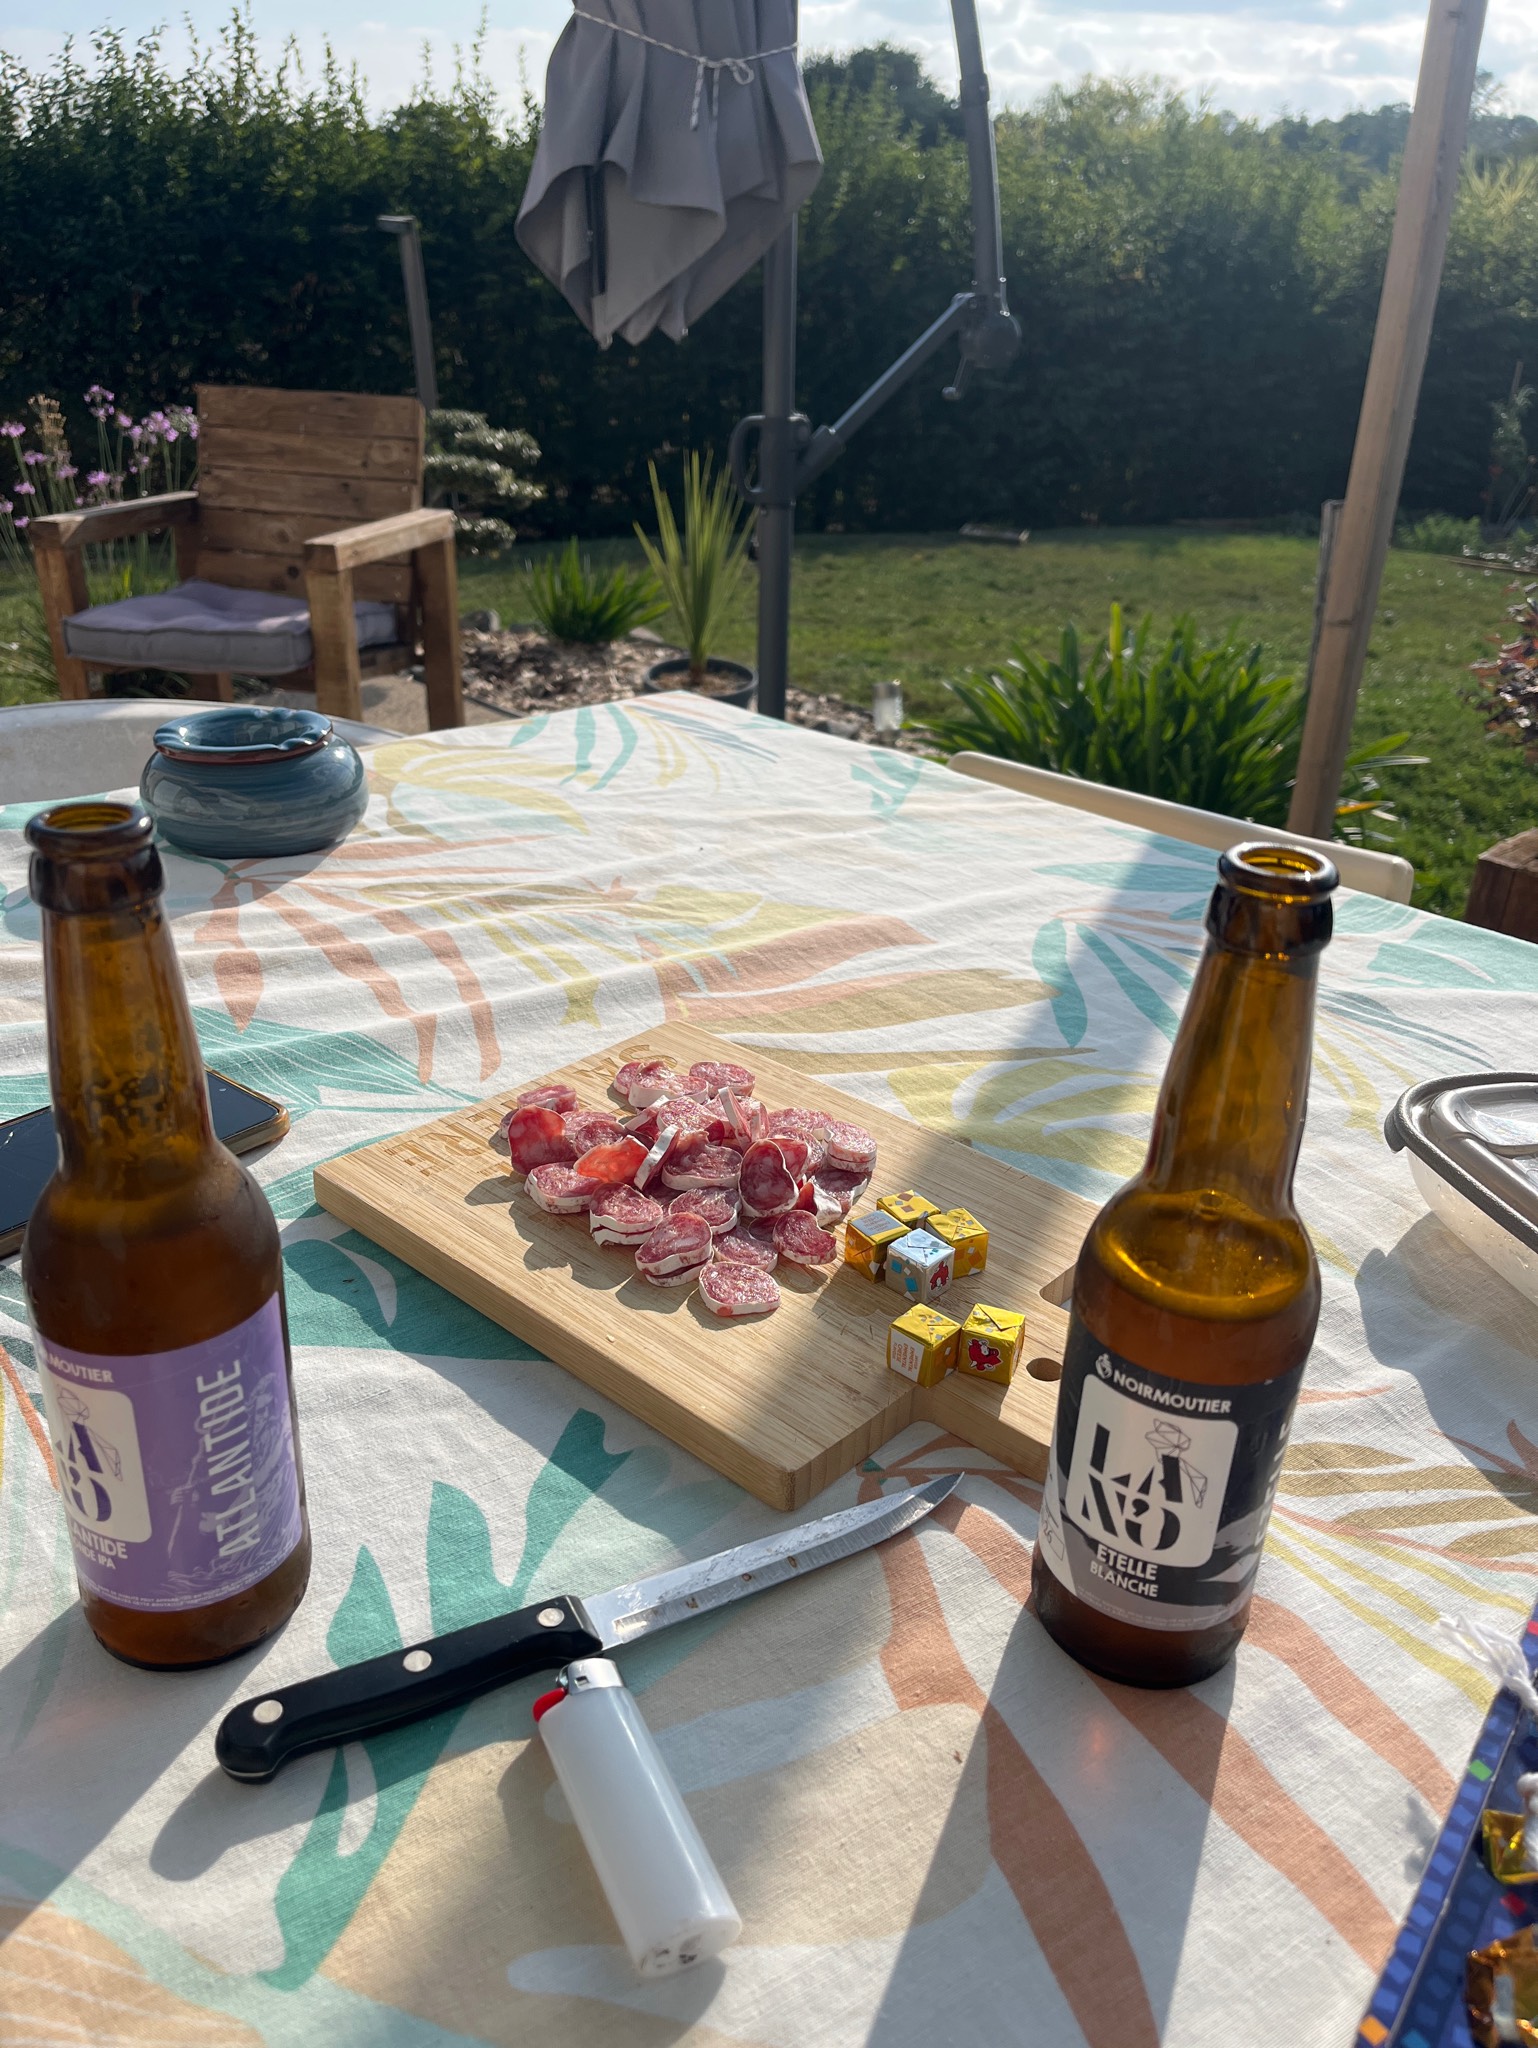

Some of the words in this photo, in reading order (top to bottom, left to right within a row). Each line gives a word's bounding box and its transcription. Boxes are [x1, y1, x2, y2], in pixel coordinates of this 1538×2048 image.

[47, 1353, 115, 1384] MOUTIER
[1113, 1369, 1232, 1413] NOIRMOUTIER
[196, 1360, 261, 1558] ATLANTIDE
[72, 1520, 129, 1560] ANTIDE
[97, 1553, 117, 1570] IPA
[1089, 1560, 1159, 1598] BLANCHE
[1096, 1543, 1159, 1581] ETELLE
